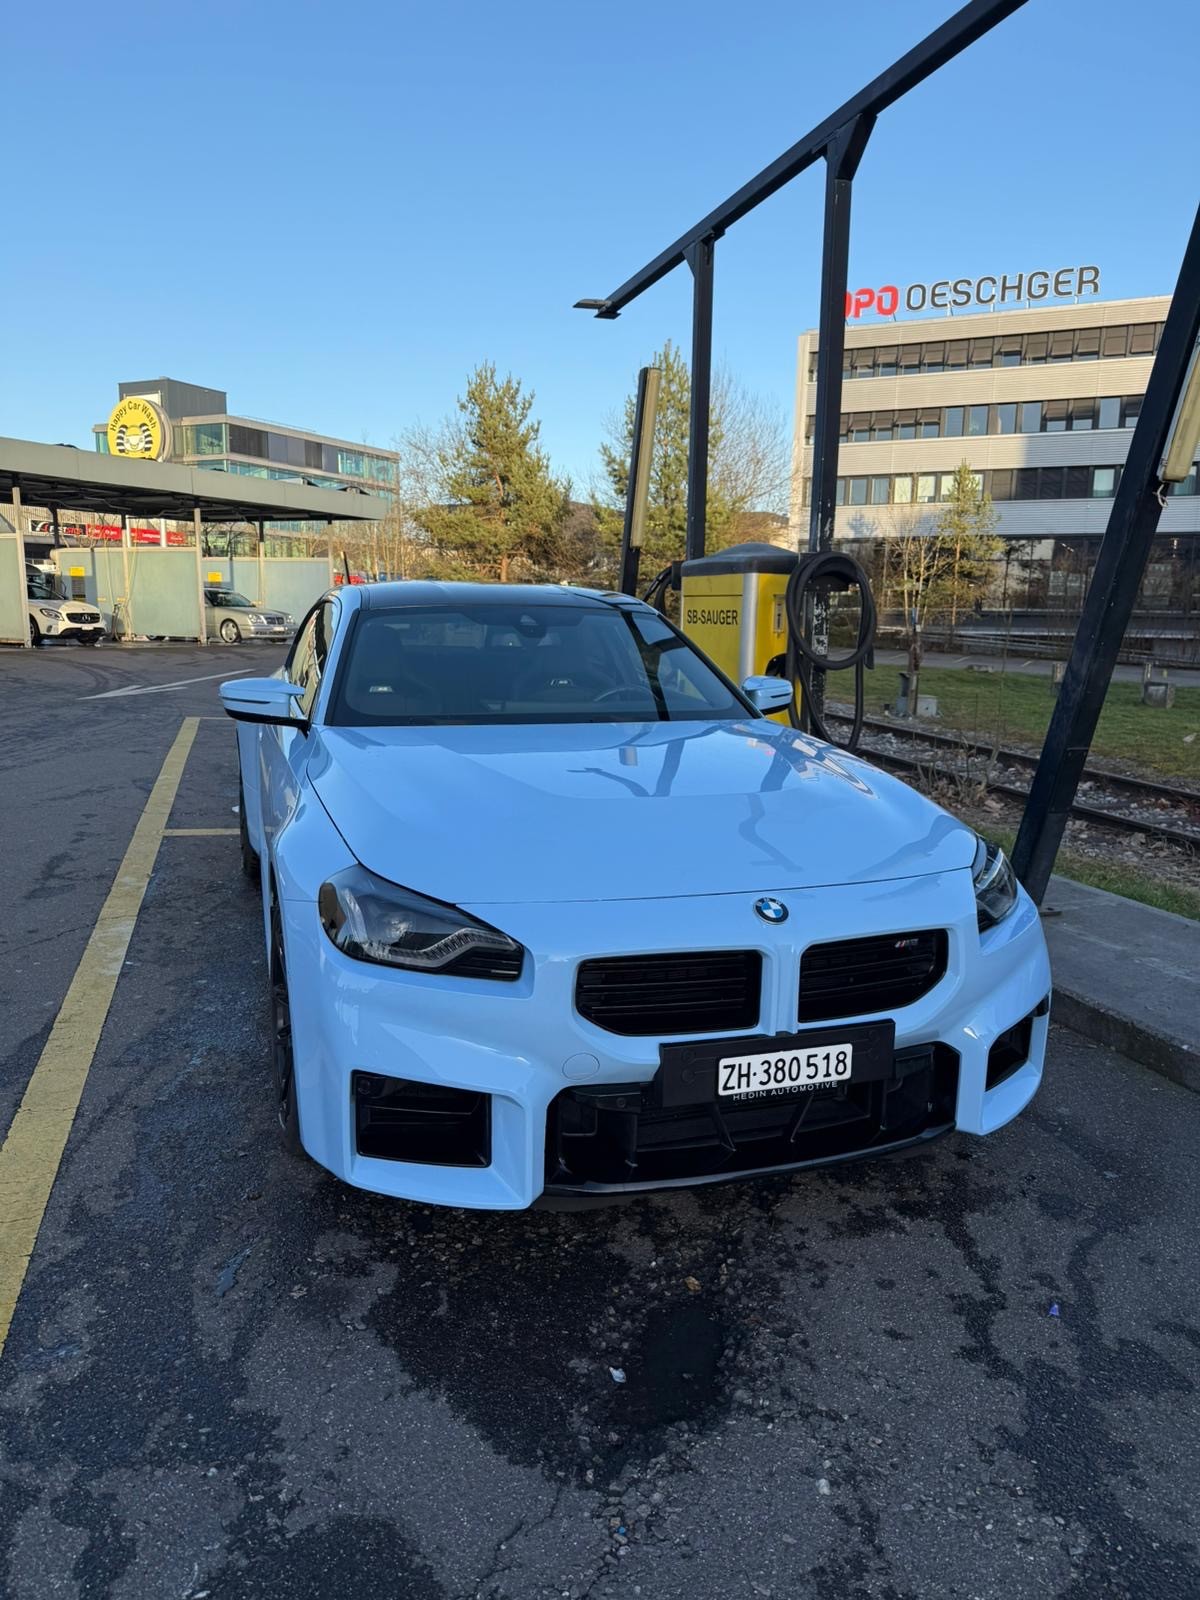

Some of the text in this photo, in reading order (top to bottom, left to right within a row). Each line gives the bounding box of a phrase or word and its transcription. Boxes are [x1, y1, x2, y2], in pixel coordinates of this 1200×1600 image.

[906, 265, 1100, 311] OESCHGER
[110, 401, 157, 432] Happy Car Wash
[687, 609, 738, 626] SB-SAUGER
[732, 1080, 838, 1101] HEDIN AUTOMOTIVE
